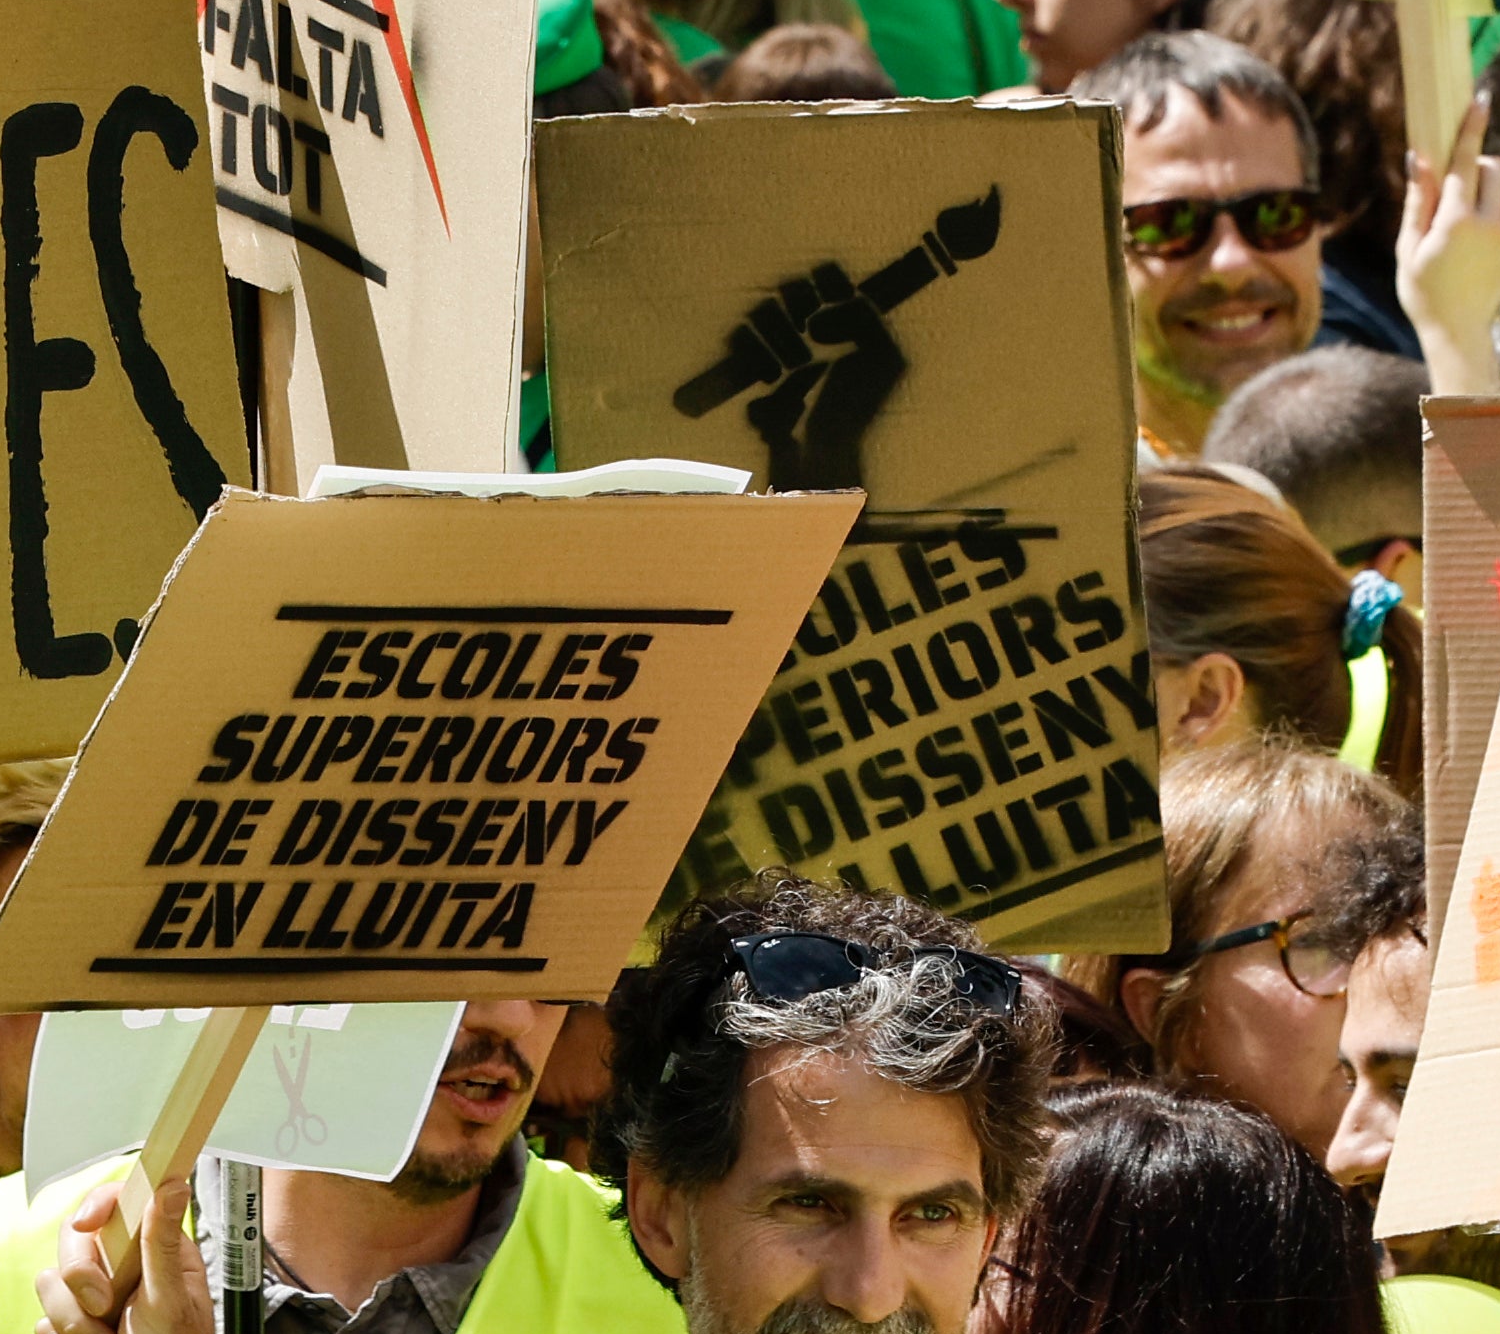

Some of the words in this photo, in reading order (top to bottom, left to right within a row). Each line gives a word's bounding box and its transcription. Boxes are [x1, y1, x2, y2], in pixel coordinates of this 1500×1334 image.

[211, 81, 331, 216] TOT
[776, 520, 1029, 673] OLES
[292, 631, 653, 701] ESCOLES
[197, 714, 661, 784] SUPERIORS
[757, 648, 1160, 864] DISSENY
[144, 799, 275, 868] DE
[270, 799, 631, 868] DISSENY
[134, 882, 265, 950] EN
[261, 882, 537, 950] LLUITA
